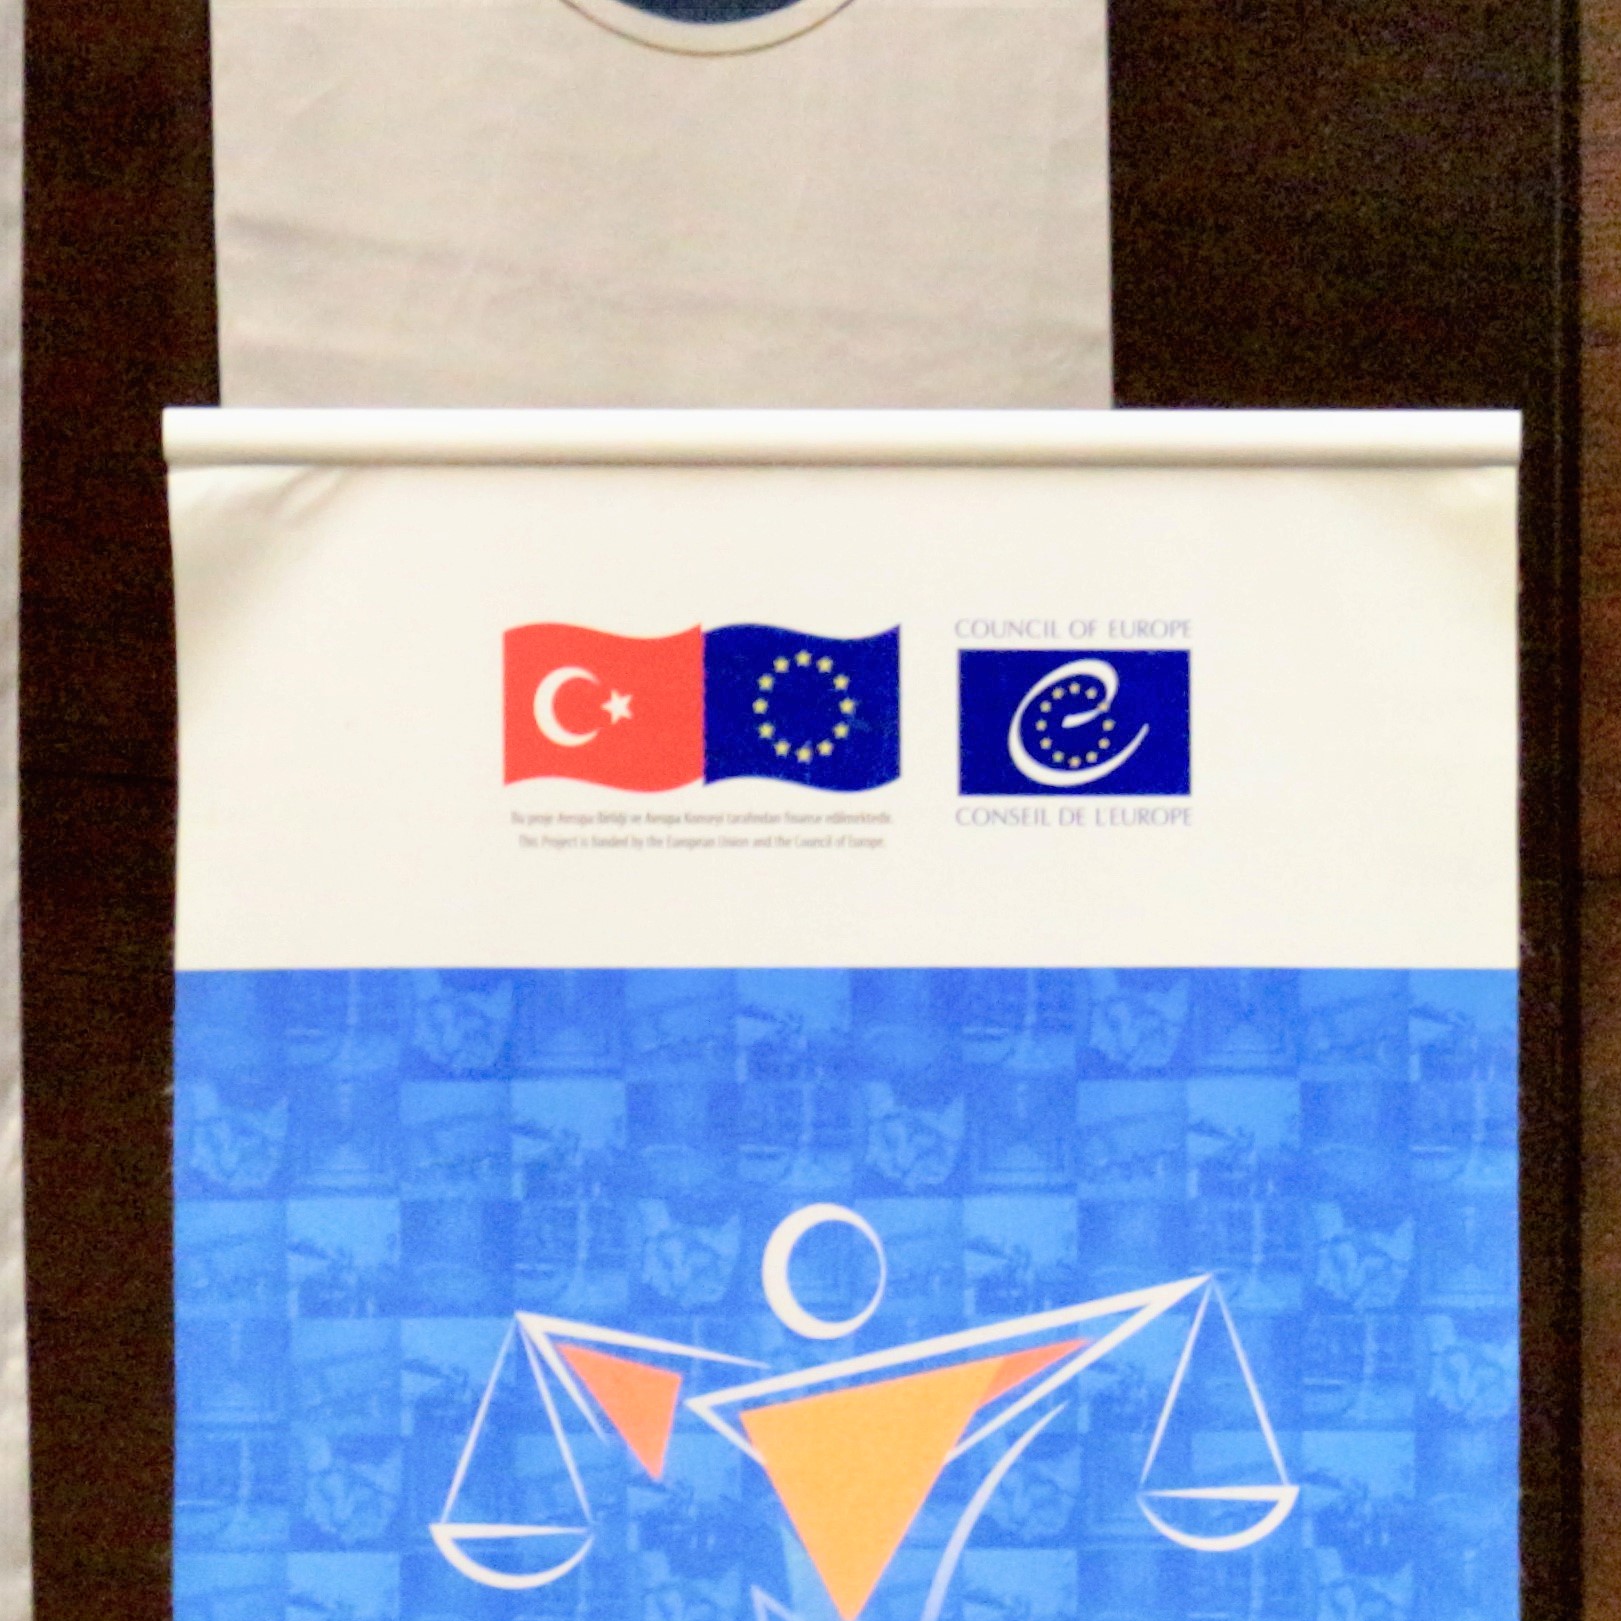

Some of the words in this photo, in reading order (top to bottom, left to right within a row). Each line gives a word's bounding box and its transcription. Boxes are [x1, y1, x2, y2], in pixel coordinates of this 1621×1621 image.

[955, 619, 1058, 639] COUNCIL
[1068, 619, 1098, 639] OF
[1108, 618, 1192, 639] EUROPE
[955, 806, 1051, 827] CONSEIL
[1059, 806, 1087, 827] DE
[1096, 806, 1192, 827] L'EUROPE
